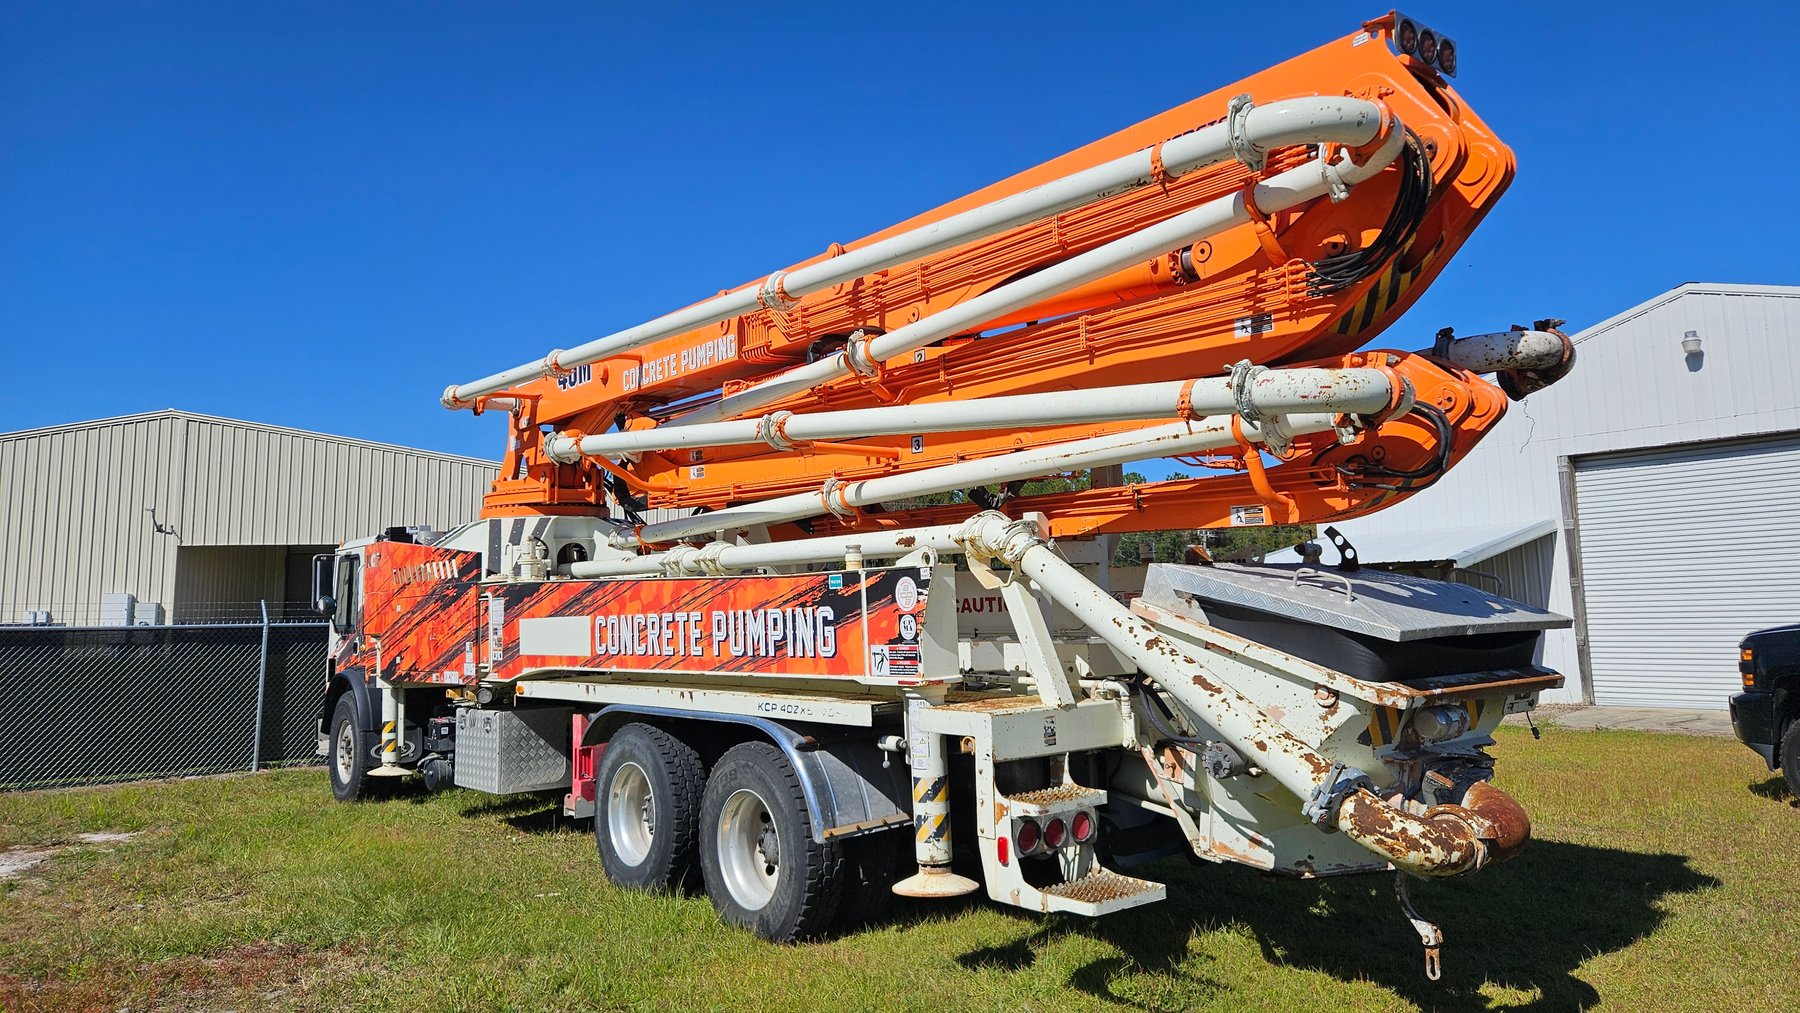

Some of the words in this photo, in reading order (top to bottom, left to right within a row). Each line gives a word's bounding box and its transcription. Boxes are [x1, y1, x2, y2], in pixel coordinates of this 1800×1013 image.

[623, 353, 677, 391] CONCRETE
[681, 334, 737, 373] PUMPING
[917, 353, 923, 363] 2
[914, 439, 920, 450] 3
[956, 597, 1009, 613] AUTI
[595, 612, 703, 656] CONCRETE
[712, 606, 837, 658] PUMPING
[757, 702, 777, 712] KCP
